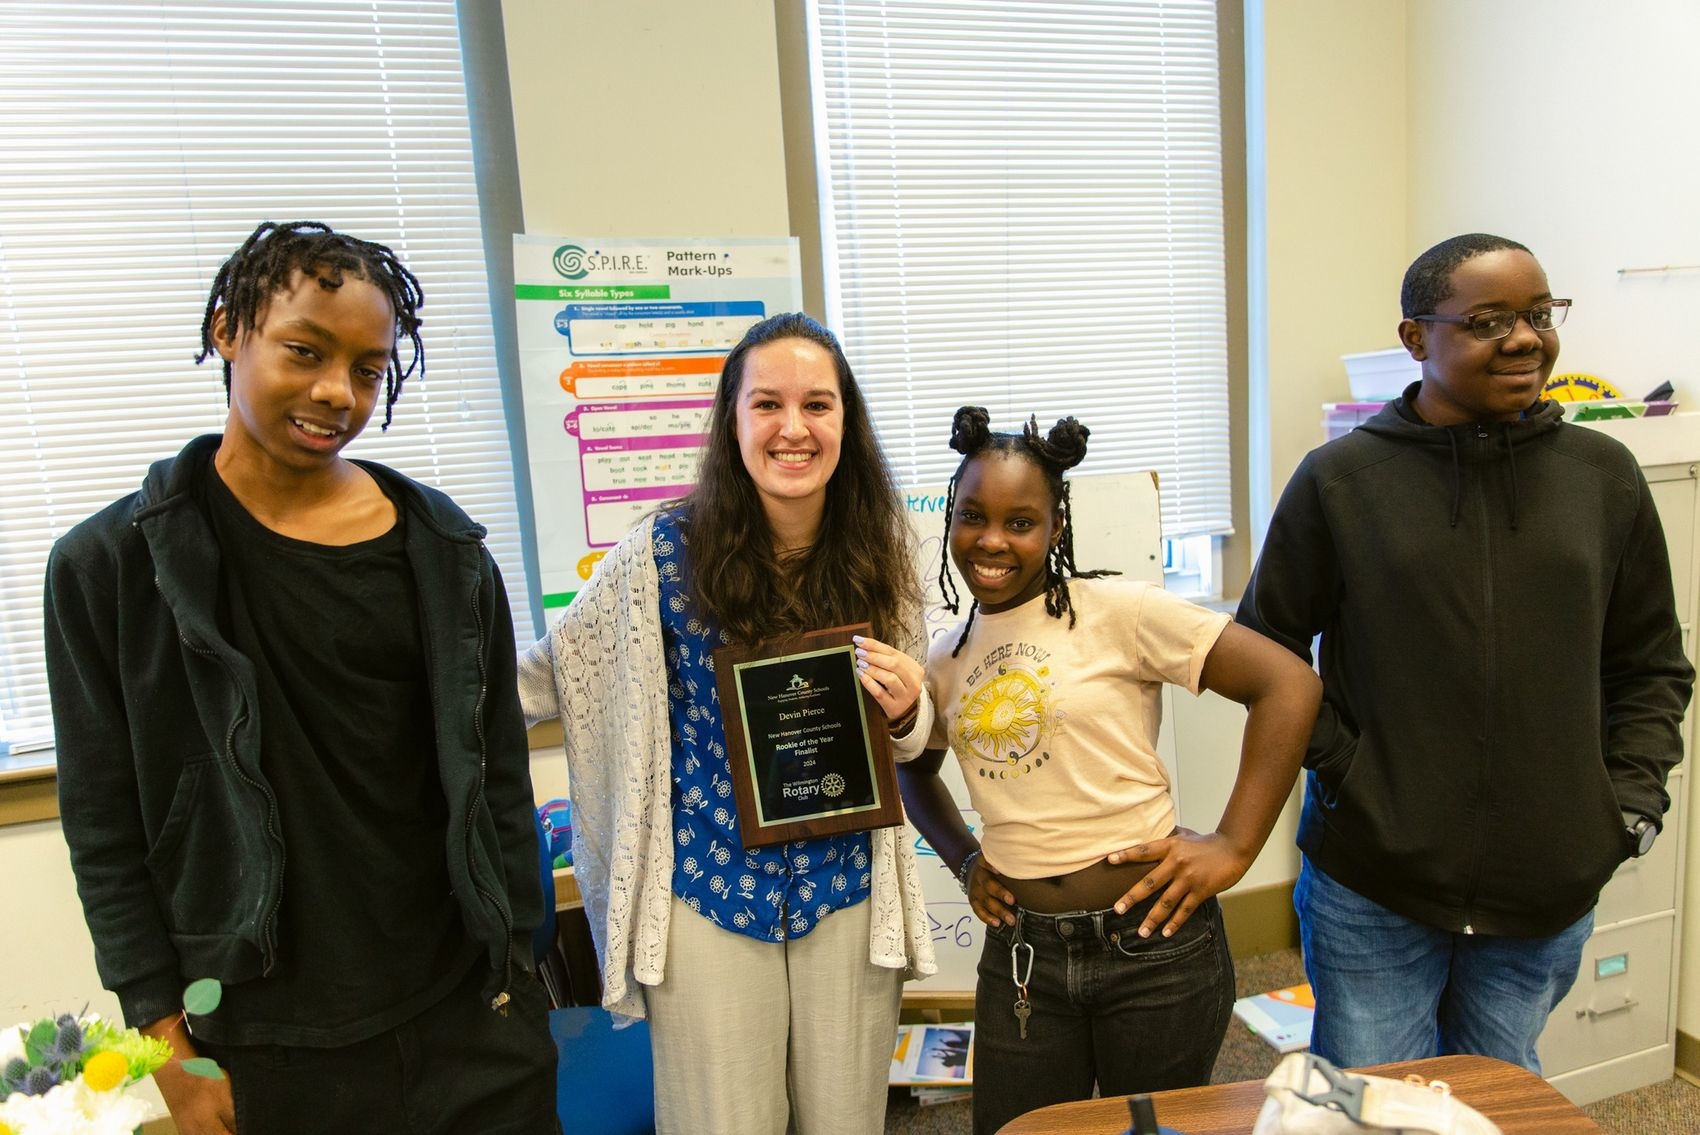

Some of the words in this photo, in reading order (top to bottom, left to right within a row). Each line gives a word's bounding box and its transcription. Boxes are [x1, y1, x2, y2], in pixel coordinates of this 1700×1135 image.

[588, 254, 648, 271] S.P.I.R.E.
[667, 250, 716, 262] Pattern
[668, 265, 733, 278] Mark-Ups
[559, 289, 572, 298] Six
[574, 288, 608, 299] Syllable
[610, 288, 634, 299] Types
[966, 665, 983, 687] BE
[983, 643, 1013, 670] HERE
[1015, 642, 1051, 663] NOW
[779, 711, 801, 721] Devin
[802, 707, 825, 717] Pierce
[780, 729, 802, 737] Hanover
[803, 726, 821, 734] County
[821, 722, 842, 731] Schools
[775, 741, 799, 751] Rookie
[799, 739, 807, 747] of
[819, 736, 834, 744] Year
[794, 747, 818, 757] Finalist
[782, 784, 820, 798] Rotary
